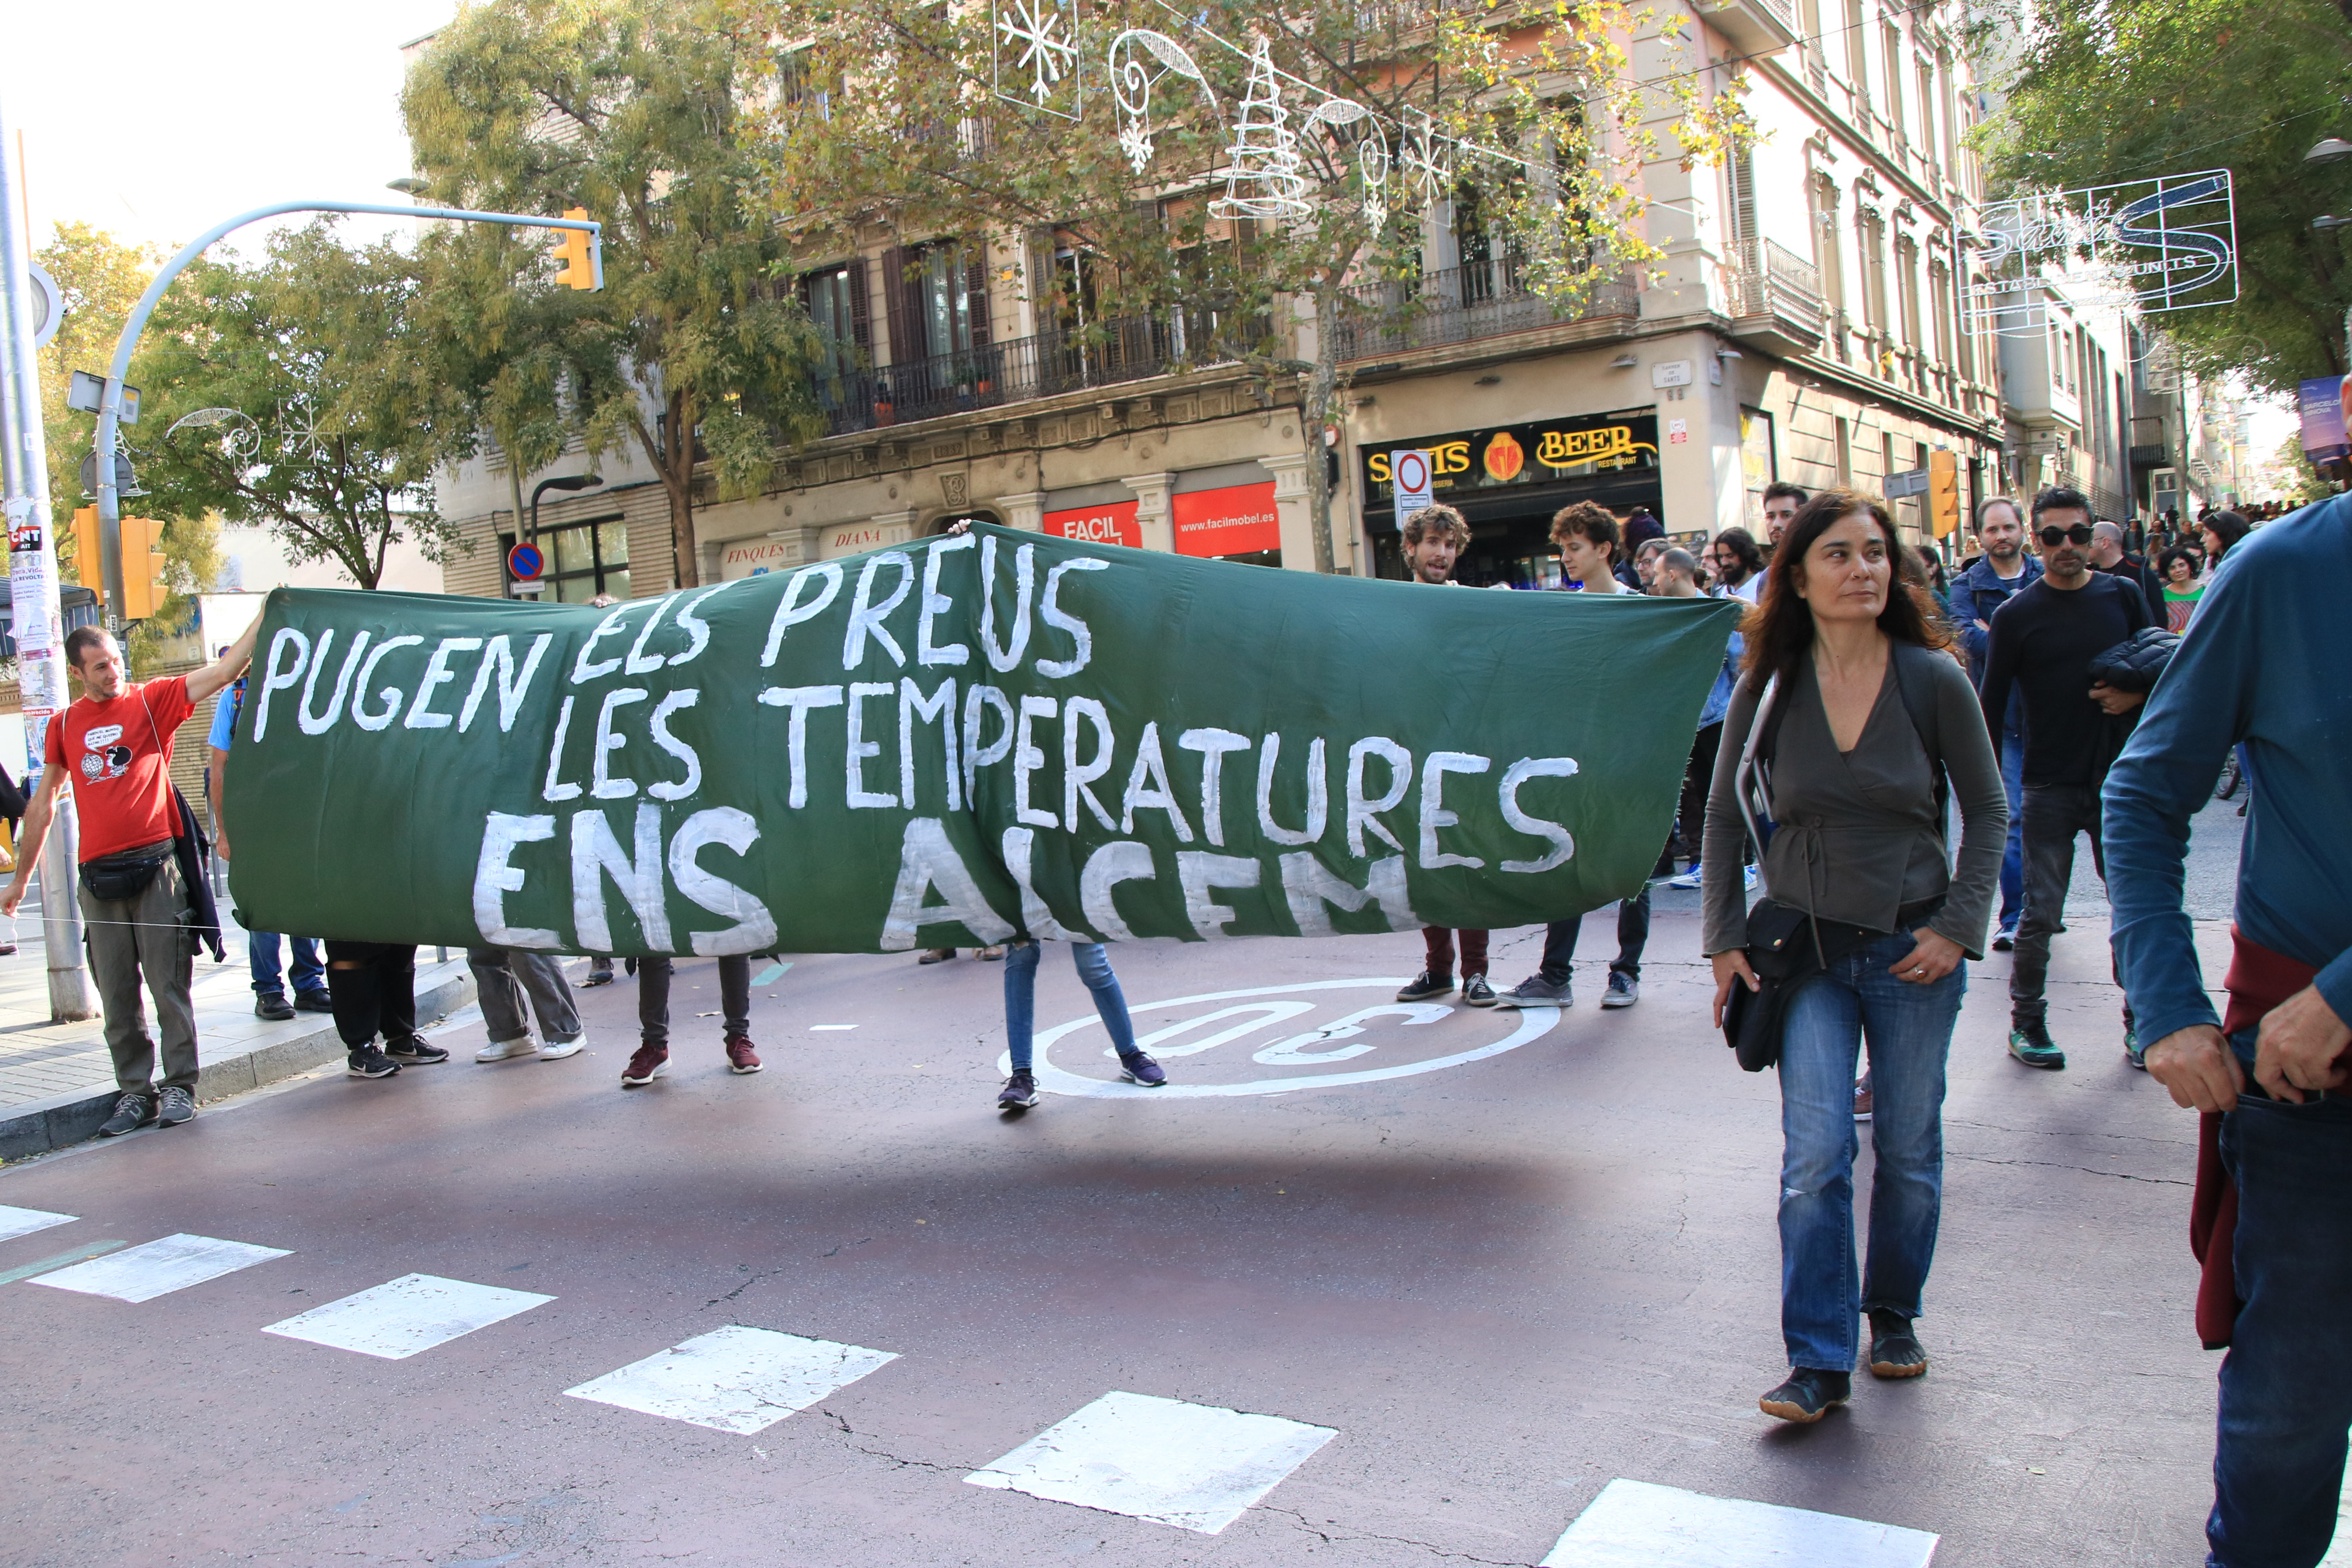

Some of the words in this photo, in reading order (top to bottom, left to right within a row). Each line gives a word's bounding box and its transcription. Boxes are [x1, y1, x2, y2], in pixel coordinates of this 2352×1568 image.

[2134, 255, 2196, 275] UNITS
[2303, 399, 2340, 411] BARCELO
[2304, 407, 2332, 417] INNOVA
[1539, 426, 1643, 464] BEER
[1368, 441, 1471, 482] STS
[1598, 456, 1637, 468] RESTAURANT
[1432, 479, 1455, 489] VESERIA
[1063, 516, 1122, 540] FACIL
[1180, 513, 1275, 532] www.facilmobel.es
[11, 530, 40, 542] CNT
[835, 530, 880, 547] DIANA
[727, 544, 784, 563] FINQUES
[253, 627, 554, 743] PUGEN
[571, 580, 742, 684] ELS
[761, 532, 1110, 678] PREUS
[543, 688, 701, 802] LES
[758, 676, 1579, 873] TEMPERATURES
[473, 797, 778, 956] ENS
